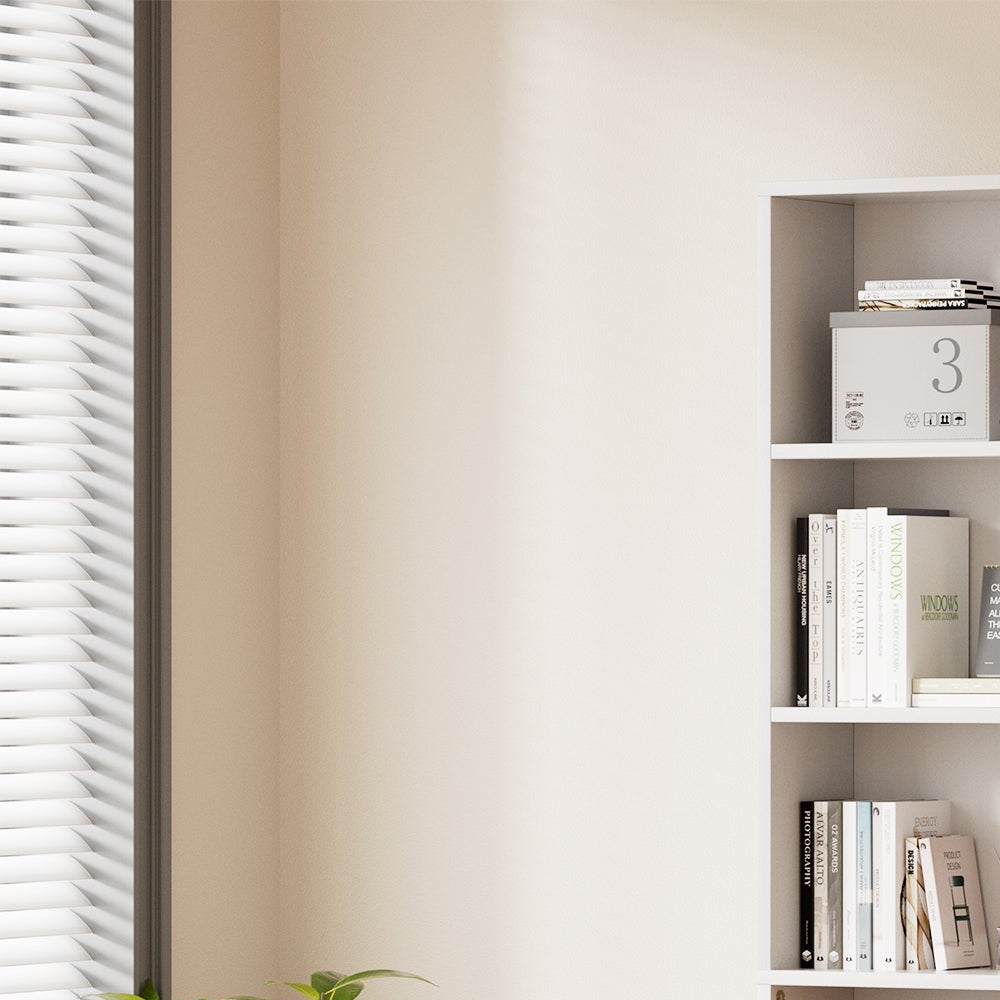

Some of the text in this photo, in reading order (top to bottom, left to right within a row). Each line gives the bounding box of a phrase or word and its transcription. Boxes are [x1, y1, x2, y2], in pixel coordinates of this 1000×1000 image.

[932, 338, 962, 393] 3
[890, 522, 903, 600] WINDOWS
[856, 560, 864, 656] ANTIQUAIRES
[920, 595, 959, 612] WINDOWS
[816, 812, 824, 885] ALVAR AALTO
